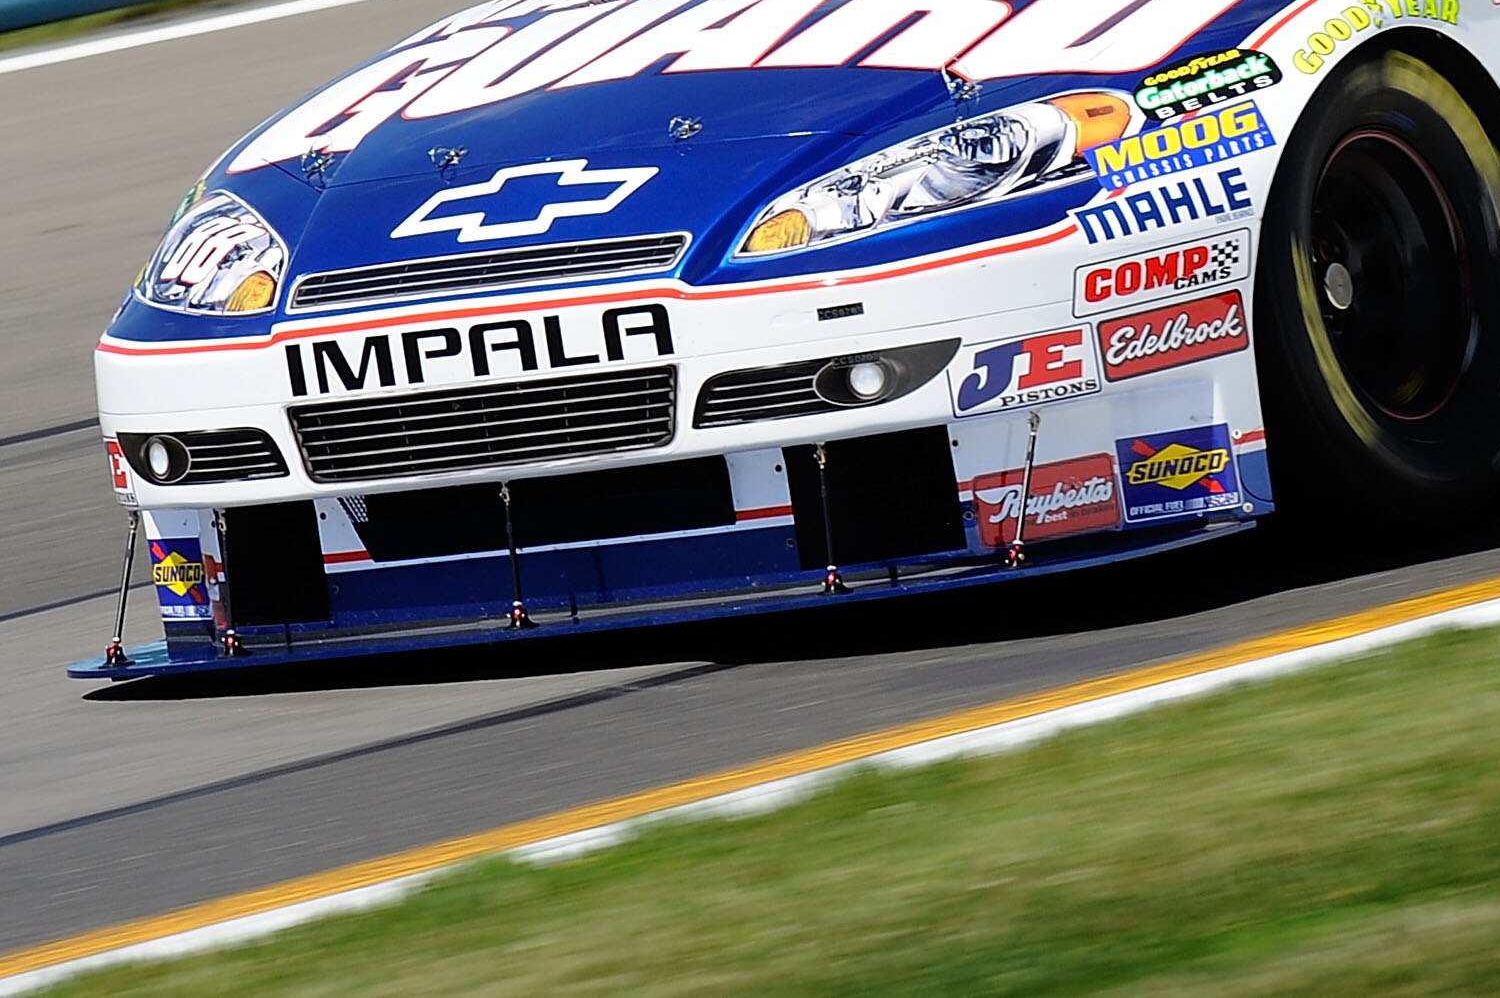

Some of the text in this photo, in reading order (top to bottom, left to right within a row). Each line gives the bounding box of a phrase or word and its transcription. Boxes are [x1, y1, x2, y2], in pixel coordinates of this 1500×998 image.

[1135, 55, 1272, 110] Gatorback
[1144, 48, 1242, 86] GOODYEAR
[1154, 74, 1274, 120] BELTS
[1095, 101, 1260, 177] MOOG
[1111, 132, 1266, 189] CHASSIS PARTS
[1075, 167, 1252, 245] MAHLE
[160, 215, 268, 287] 88
[1084, 244, 1209, 303] COMP
[1173, 265, 1232, 291] CAMS
[285, 304, 675, 397] IMPALA
[1105, 303, 1244, 365] Edelbrock
[958, 329, 1083, 411] JE
[1000, 378, 1098, 407] PISTONS
[1132, 452, 1223, 482] SUNOCO
[154, 565, 201, 584] SUNOCO
